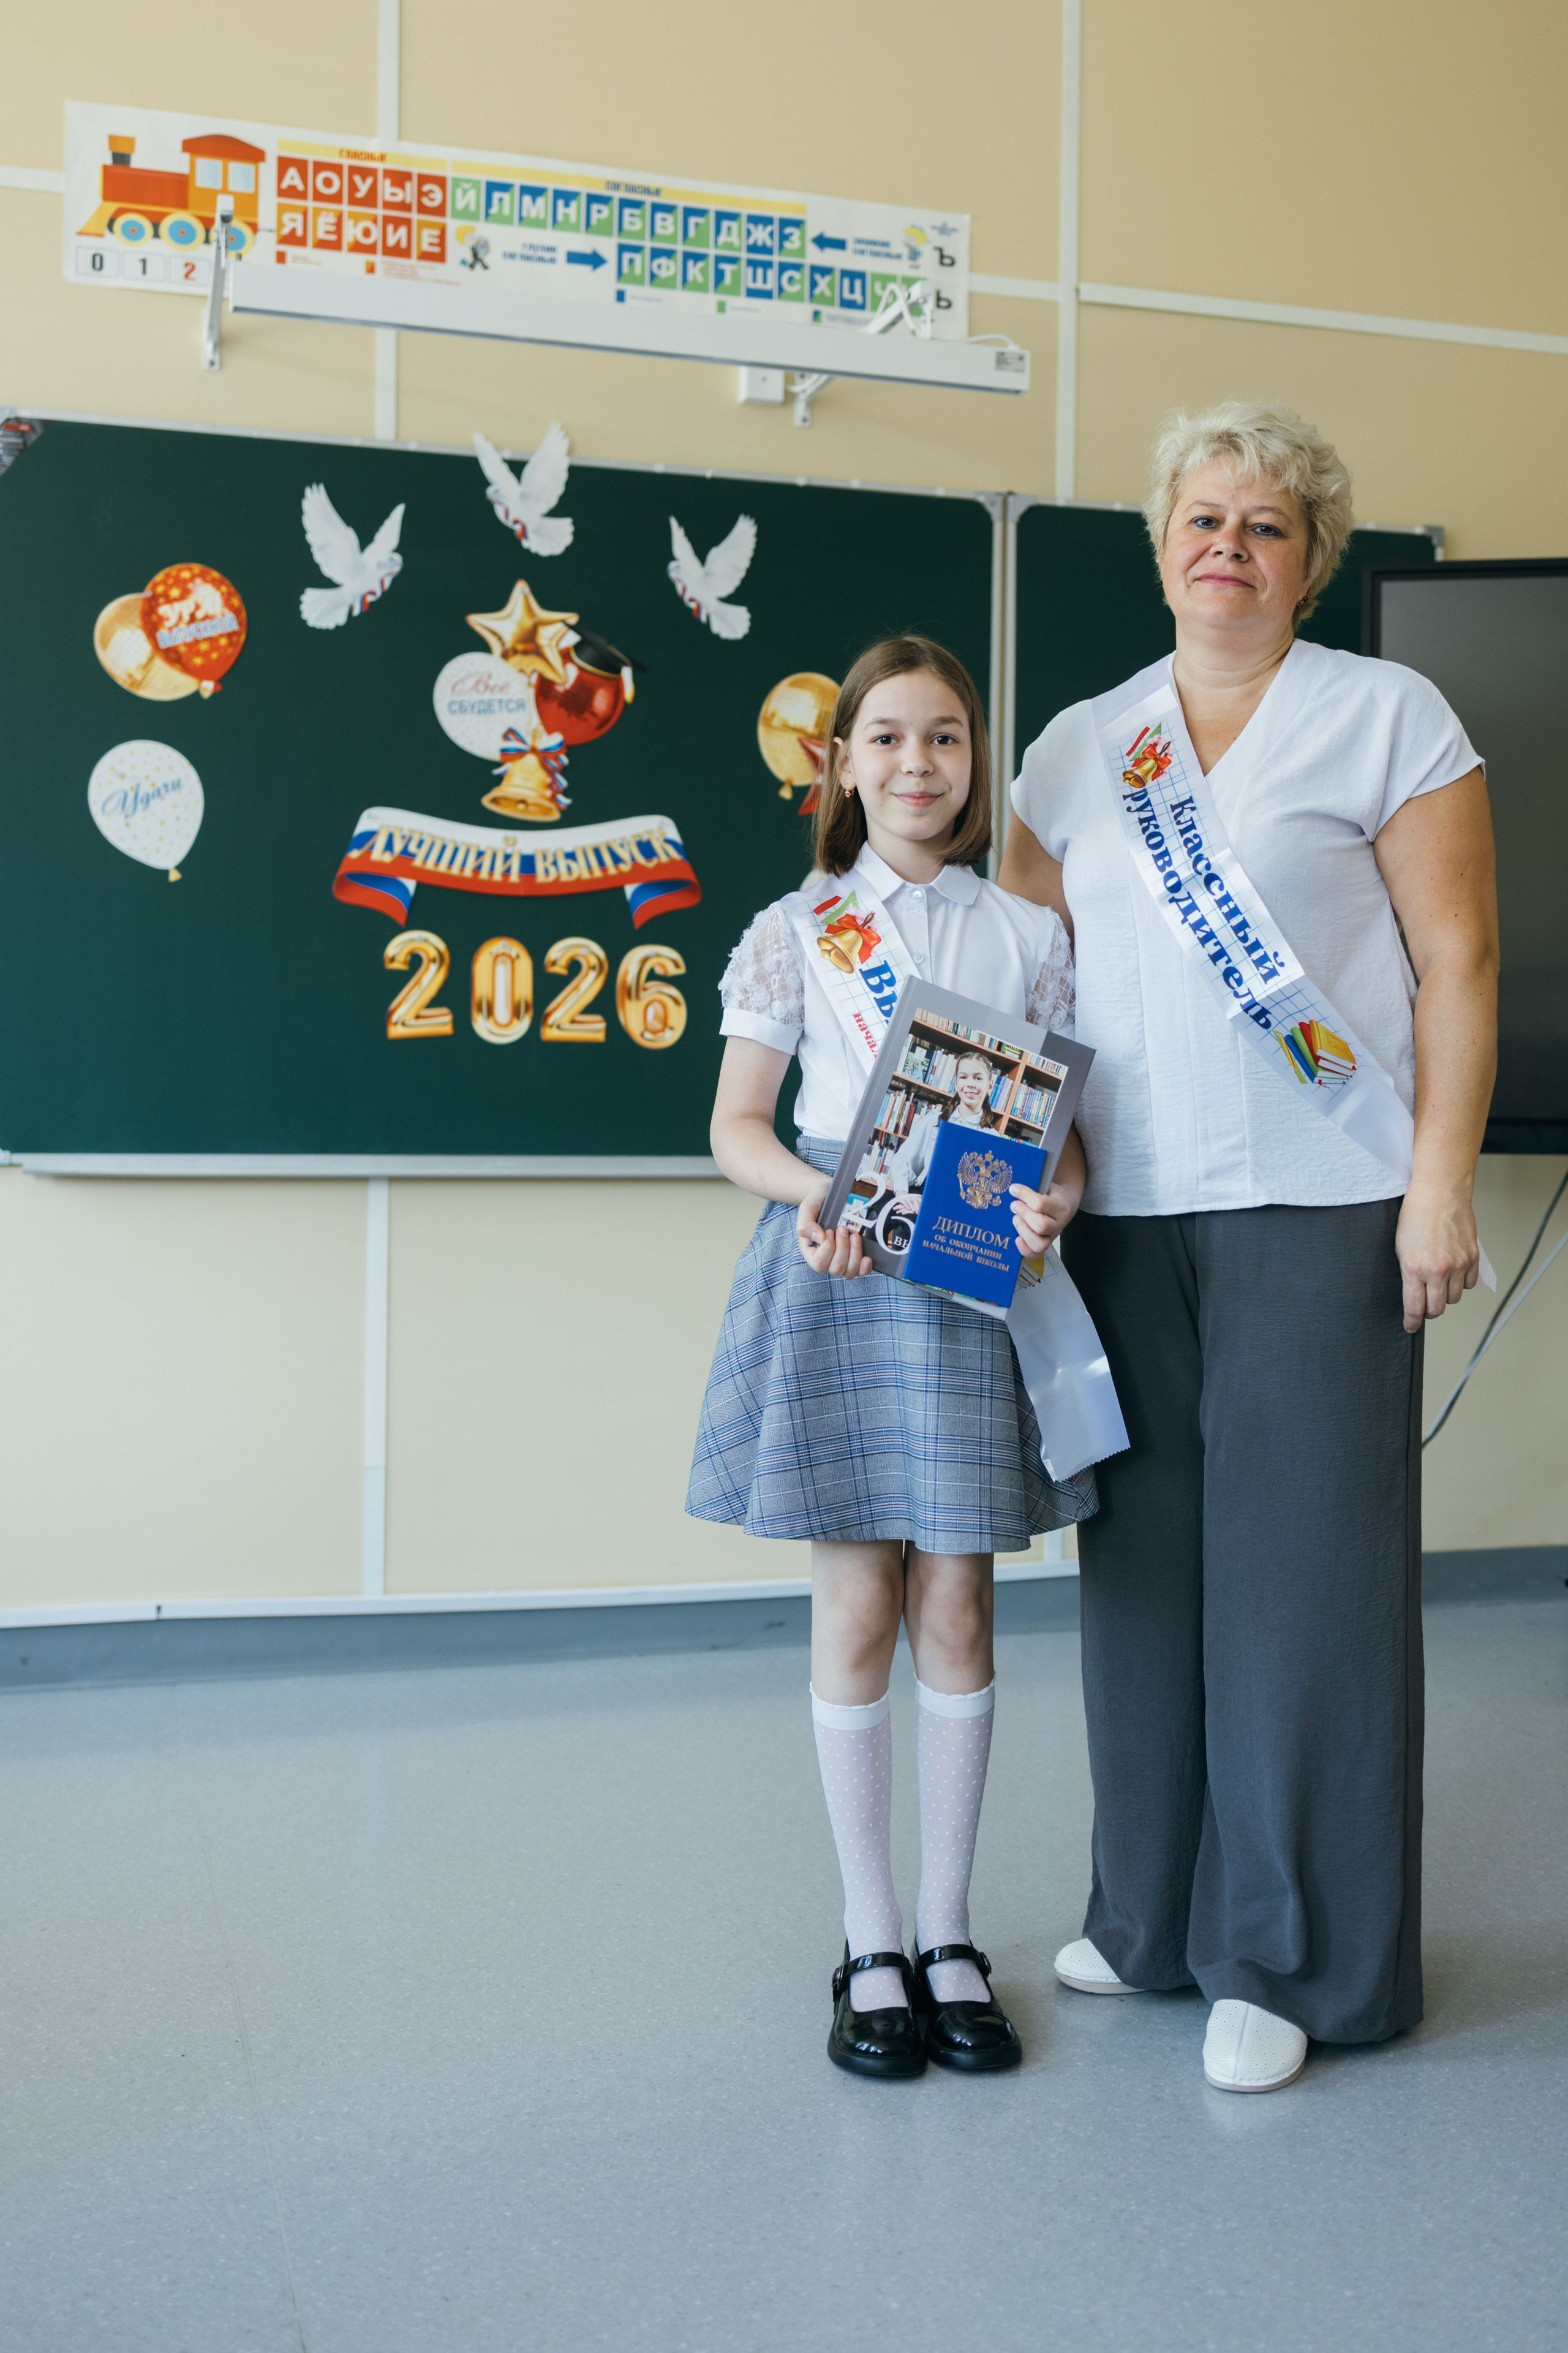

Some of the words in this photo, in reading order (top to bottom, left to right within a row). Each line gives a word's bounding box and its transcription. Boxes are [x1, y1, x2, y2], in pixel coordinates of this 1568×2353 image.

[279, 167, 305, 191] А
[315, 170, 341, 195] О
[352, 174, 374, 198] У
[383, 178, 412, 204] Ы
[420, 183, 443, 207] Э
[281, 212, 304, 237] Я
[317, 211, 337, 241] Ё
[347, 219, 379, 244] Ю
[386, 224, 407, 249] И
[420, 228, 441, 253] Е
[455, 181, 477, 212] Й
[488, 191, 511, 216] Л
[521, 194, 546, 220] М
[556, 198, 577, 223] Н
[590, 203, 609, 227] Р
[622, 207, 643, 232] Б
[654, 211, 676, 235] В
[687, 216, 706, 238] Г
[717, 219, 740, 248] Д
[747, 222, 774, 247] Ж
[782, 226, 802, 249] З
[91, 252, 104, 271] 0
[139, 257, 147, 275] 1
[184, 262, 196, 281] 2
[933, 245, 956, 267] Ъ
[622, 252, 641, 276] П
[650, 256, 676, 279] Ф
[686, 259, 705, 284] К
[717, 262, 738, 286] Т
[747, 266, 774, 291] Ш
[780, 270, 802, 293] С
[812, 273, 832, 297] Х
[842, 277, 864, 306] Ц
[156, 611, 239, 649] ВЫПУСКНОЙ
[447, 697, 526, 715] СБУДЕТСЯ
[100, 777, 182, 820] Удачи
[349, 825, 520, 883] ЛУЧШИЙ
[534, 826, 683, 883] ВЫПУСК
[1123, 788, 1272, 1032] руководитель
[1170, 796, 1286, 985] Классный
[383, 929, 687, 1049] 2026
[932, 1216, 1011, 1250] ДИПЛОМ
[935, 1234, 946, 1243] ОБ
[949, 1239, 1002, 1260] ОКОНЧАНИИ
[922, 1239, 973, 1261] НАЧАЛЬНОЙ
[976, 1258, 1010, 1272] ШКОЛЫ
